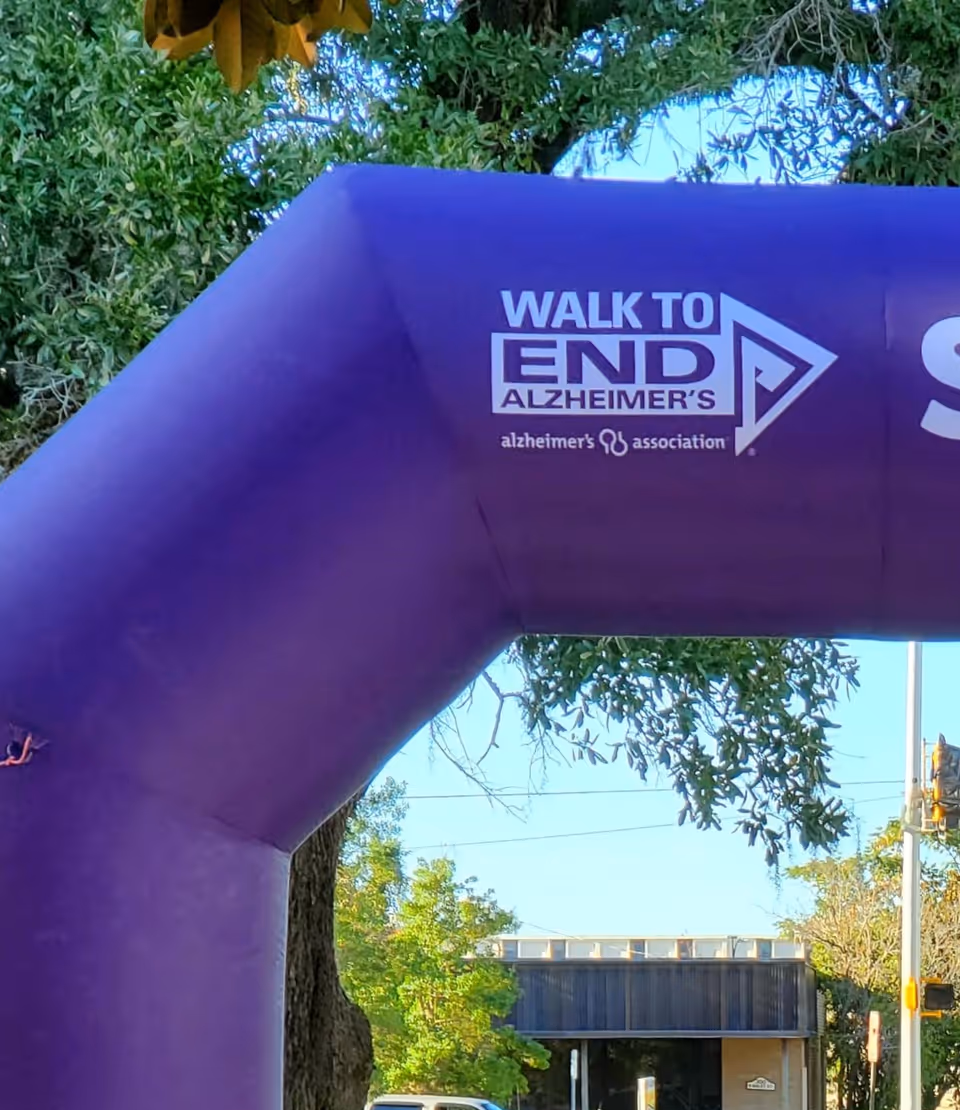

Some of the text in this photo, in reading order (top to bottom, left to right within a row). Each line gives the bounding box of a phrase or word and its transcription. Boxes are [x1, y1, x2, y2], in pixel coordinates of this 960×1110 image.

[501, 290, 714, 329] WALK TO
[503, 339, 716, 385] END
[501, 389, 716, 410] ALZHEIMER'S
[501, 432, 726, 449] alzheimer's association
